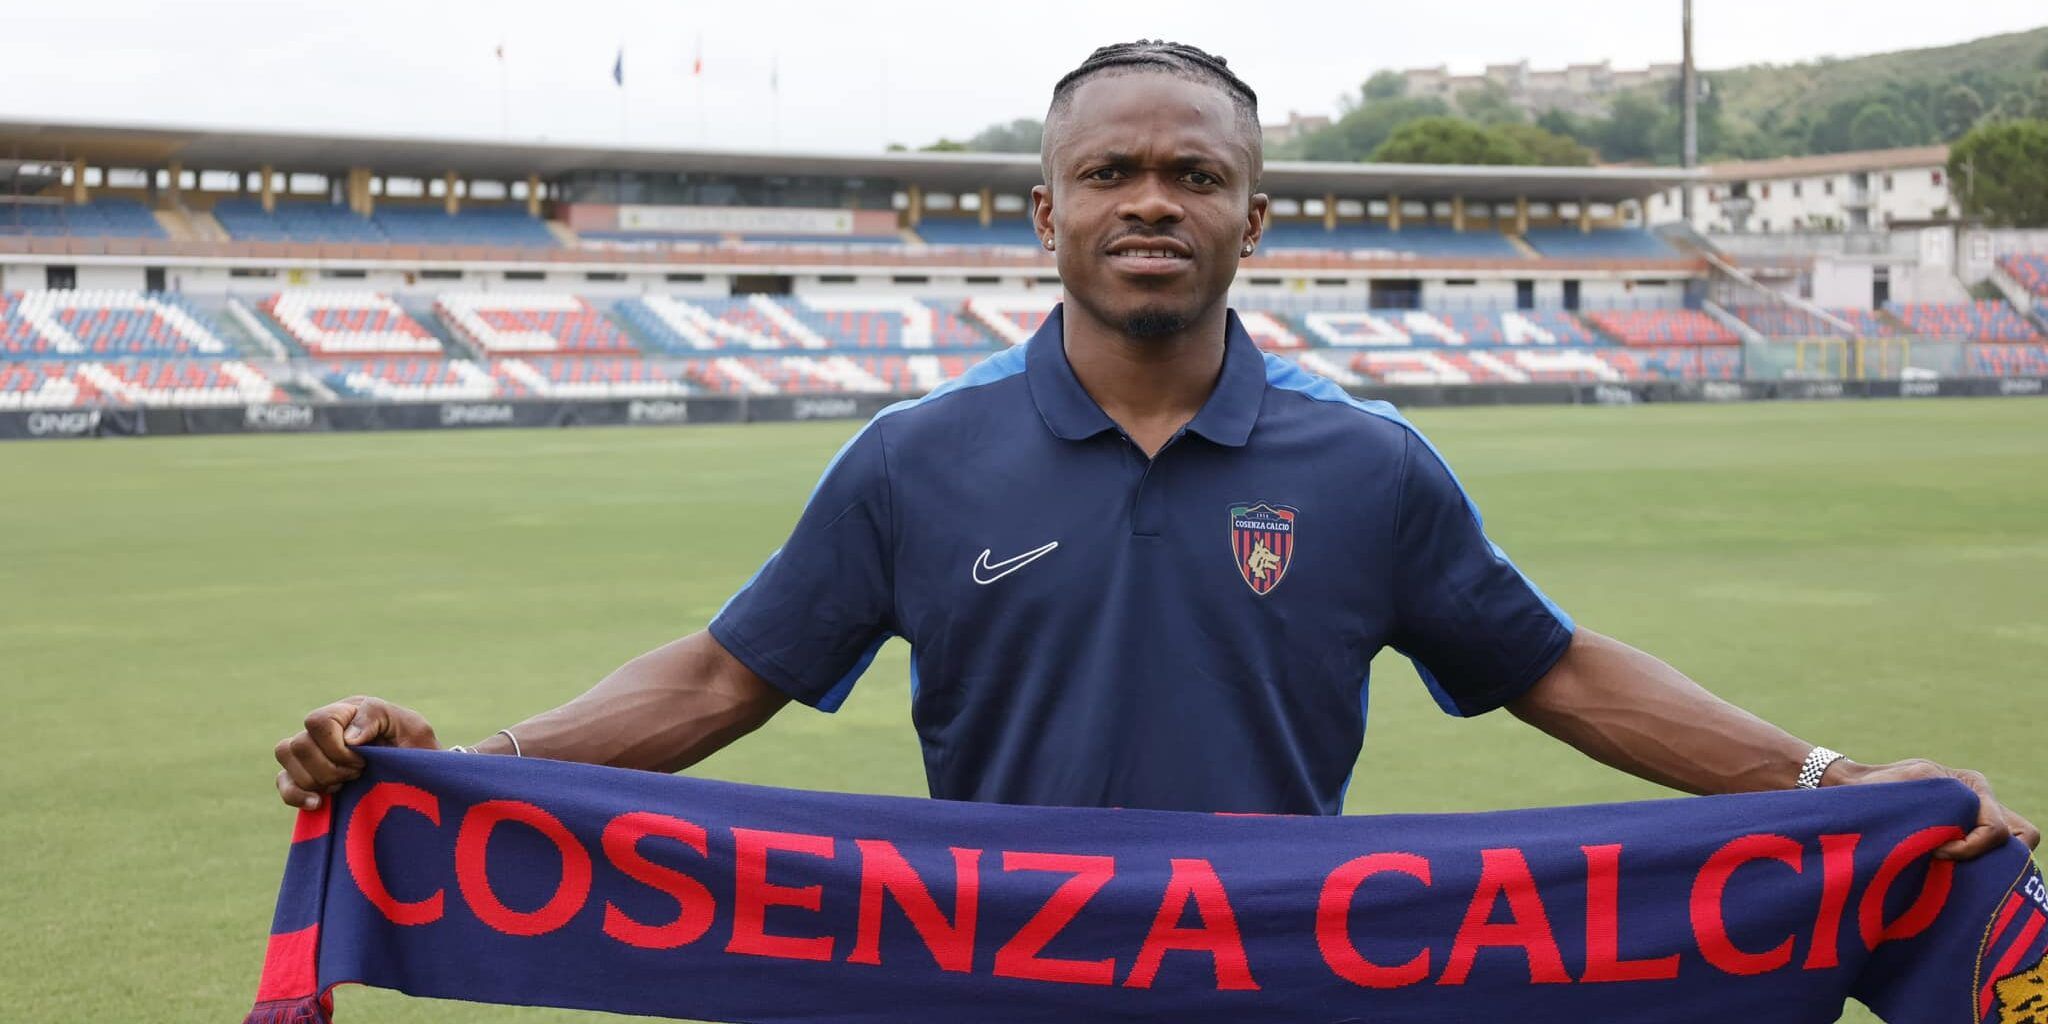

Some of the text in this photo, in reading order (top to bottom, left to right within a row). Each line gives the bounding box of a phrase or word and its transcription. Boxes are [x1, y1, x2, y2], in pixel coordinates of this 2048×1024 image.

[1235, 520, 1290, 531] COSENZA CALCIO
[345, 781, 1965, 990] COSENZA CALCIO
